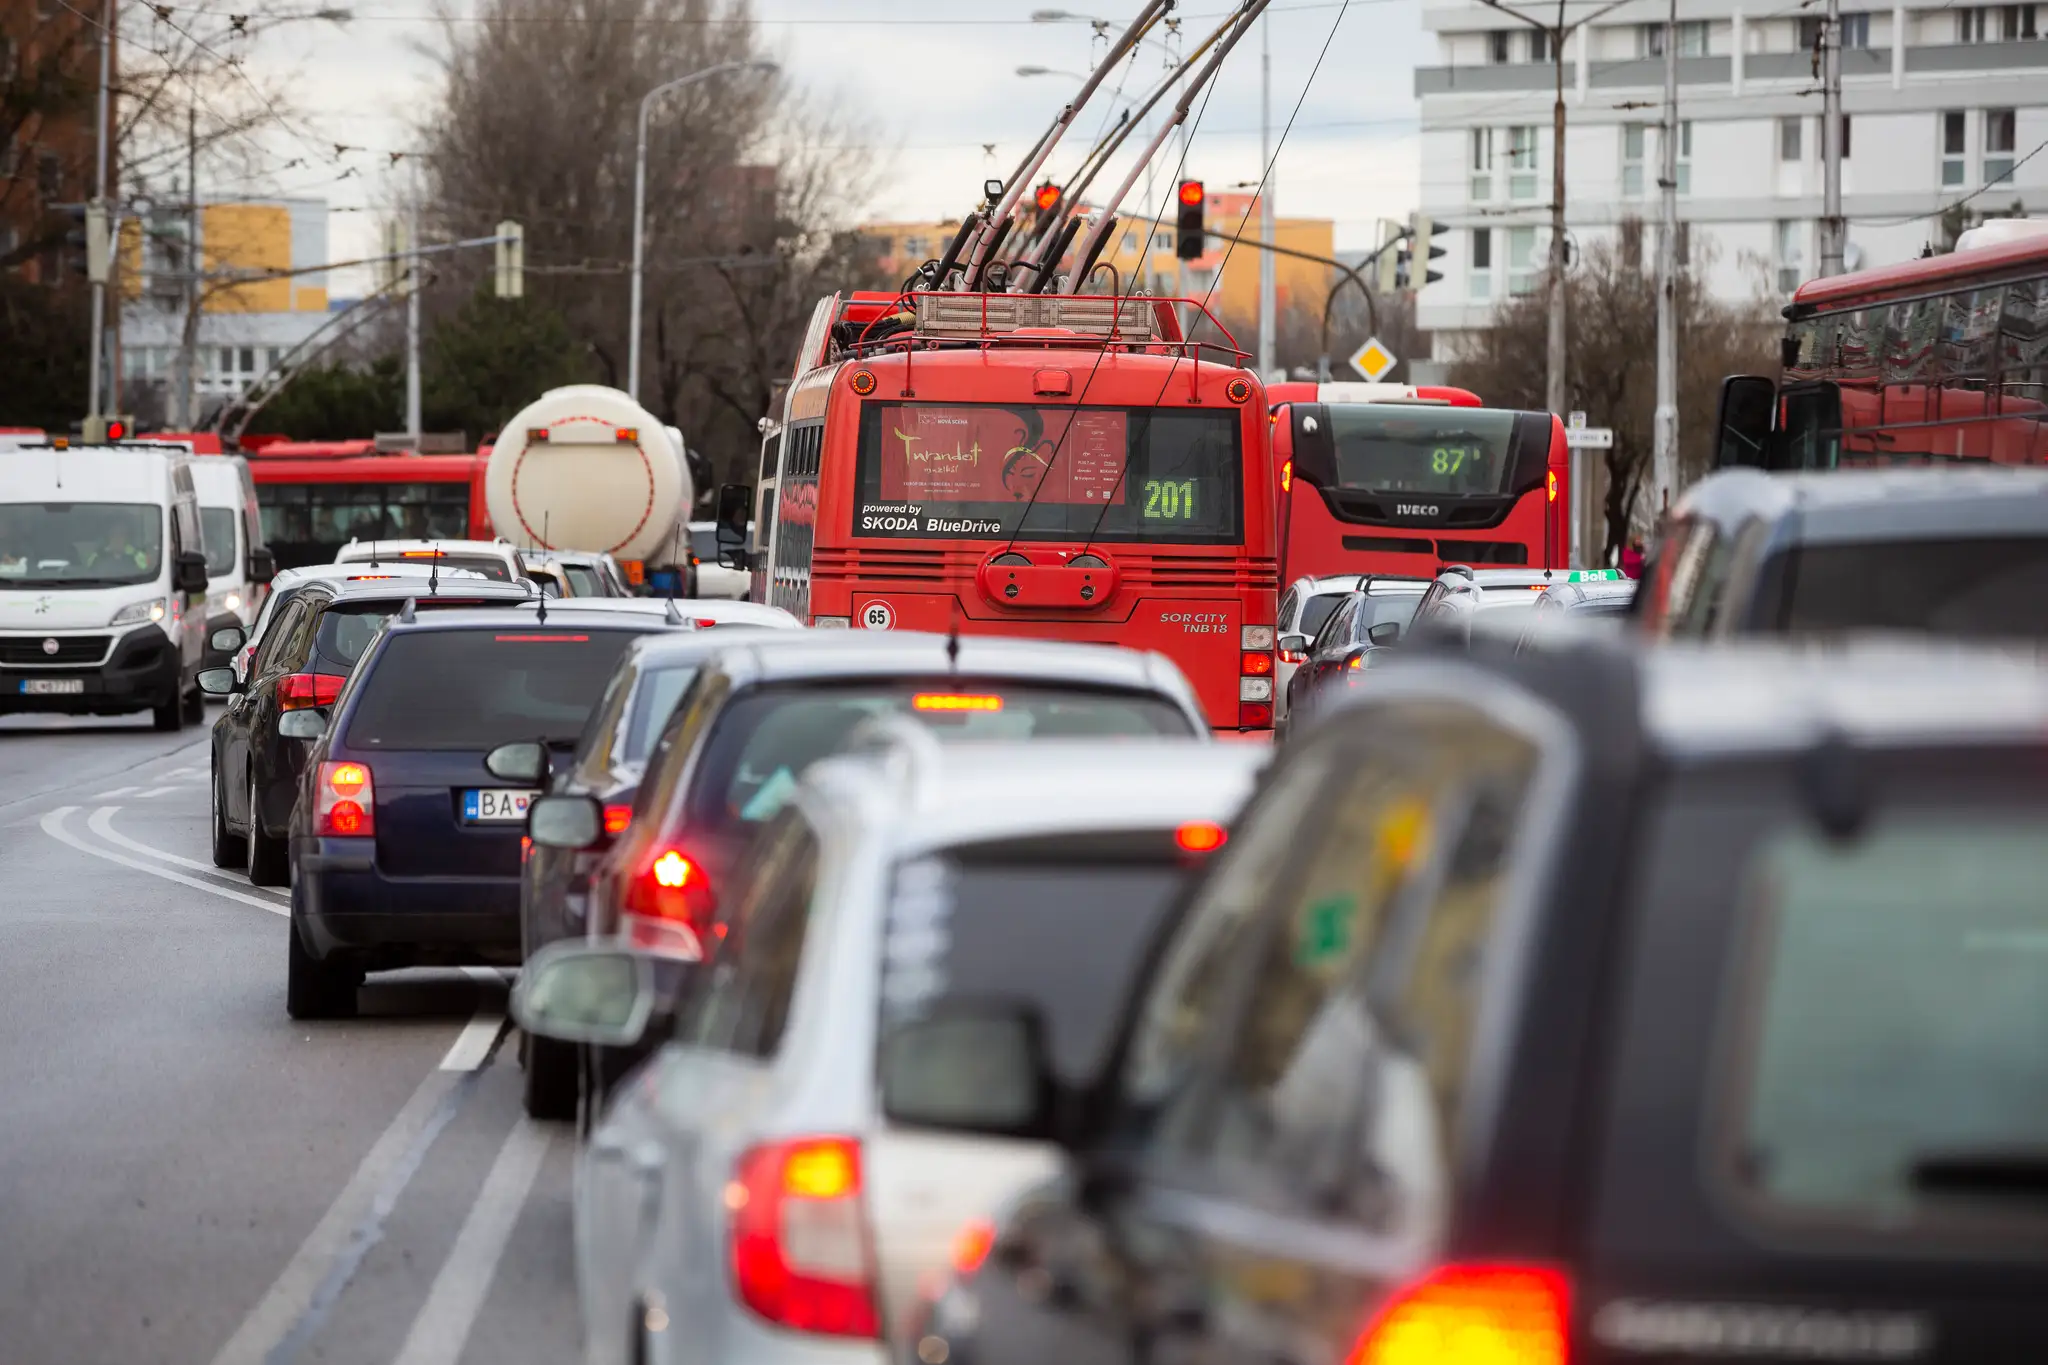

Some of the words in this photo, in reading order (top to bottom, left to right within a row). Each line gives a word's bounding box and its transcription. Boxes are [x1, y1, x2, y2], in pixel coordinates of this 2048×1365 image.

[894, 426, 982, 468] Turandot
[1432, 448, 1465, 475] 87
[1144, 480, 1192, 518] 201
[862, 504, 906, 514] powered
[908, 504, 922, 516] by
[1396, 504, 1440, 516] IVECO
[862, 516, 918, 531] SKODA
[926, 518, 1000, 533] BlueDrive
[1580, 569, 1608, 582] Bolt
[868, 610, 886, 624] 65
[1160, 613, 1192, 622] SOR
[1194, 613, 1227, 623] CITY
[1184, 624, 1210, 633] TNB
[1212, 624, 1228, 634] 18
